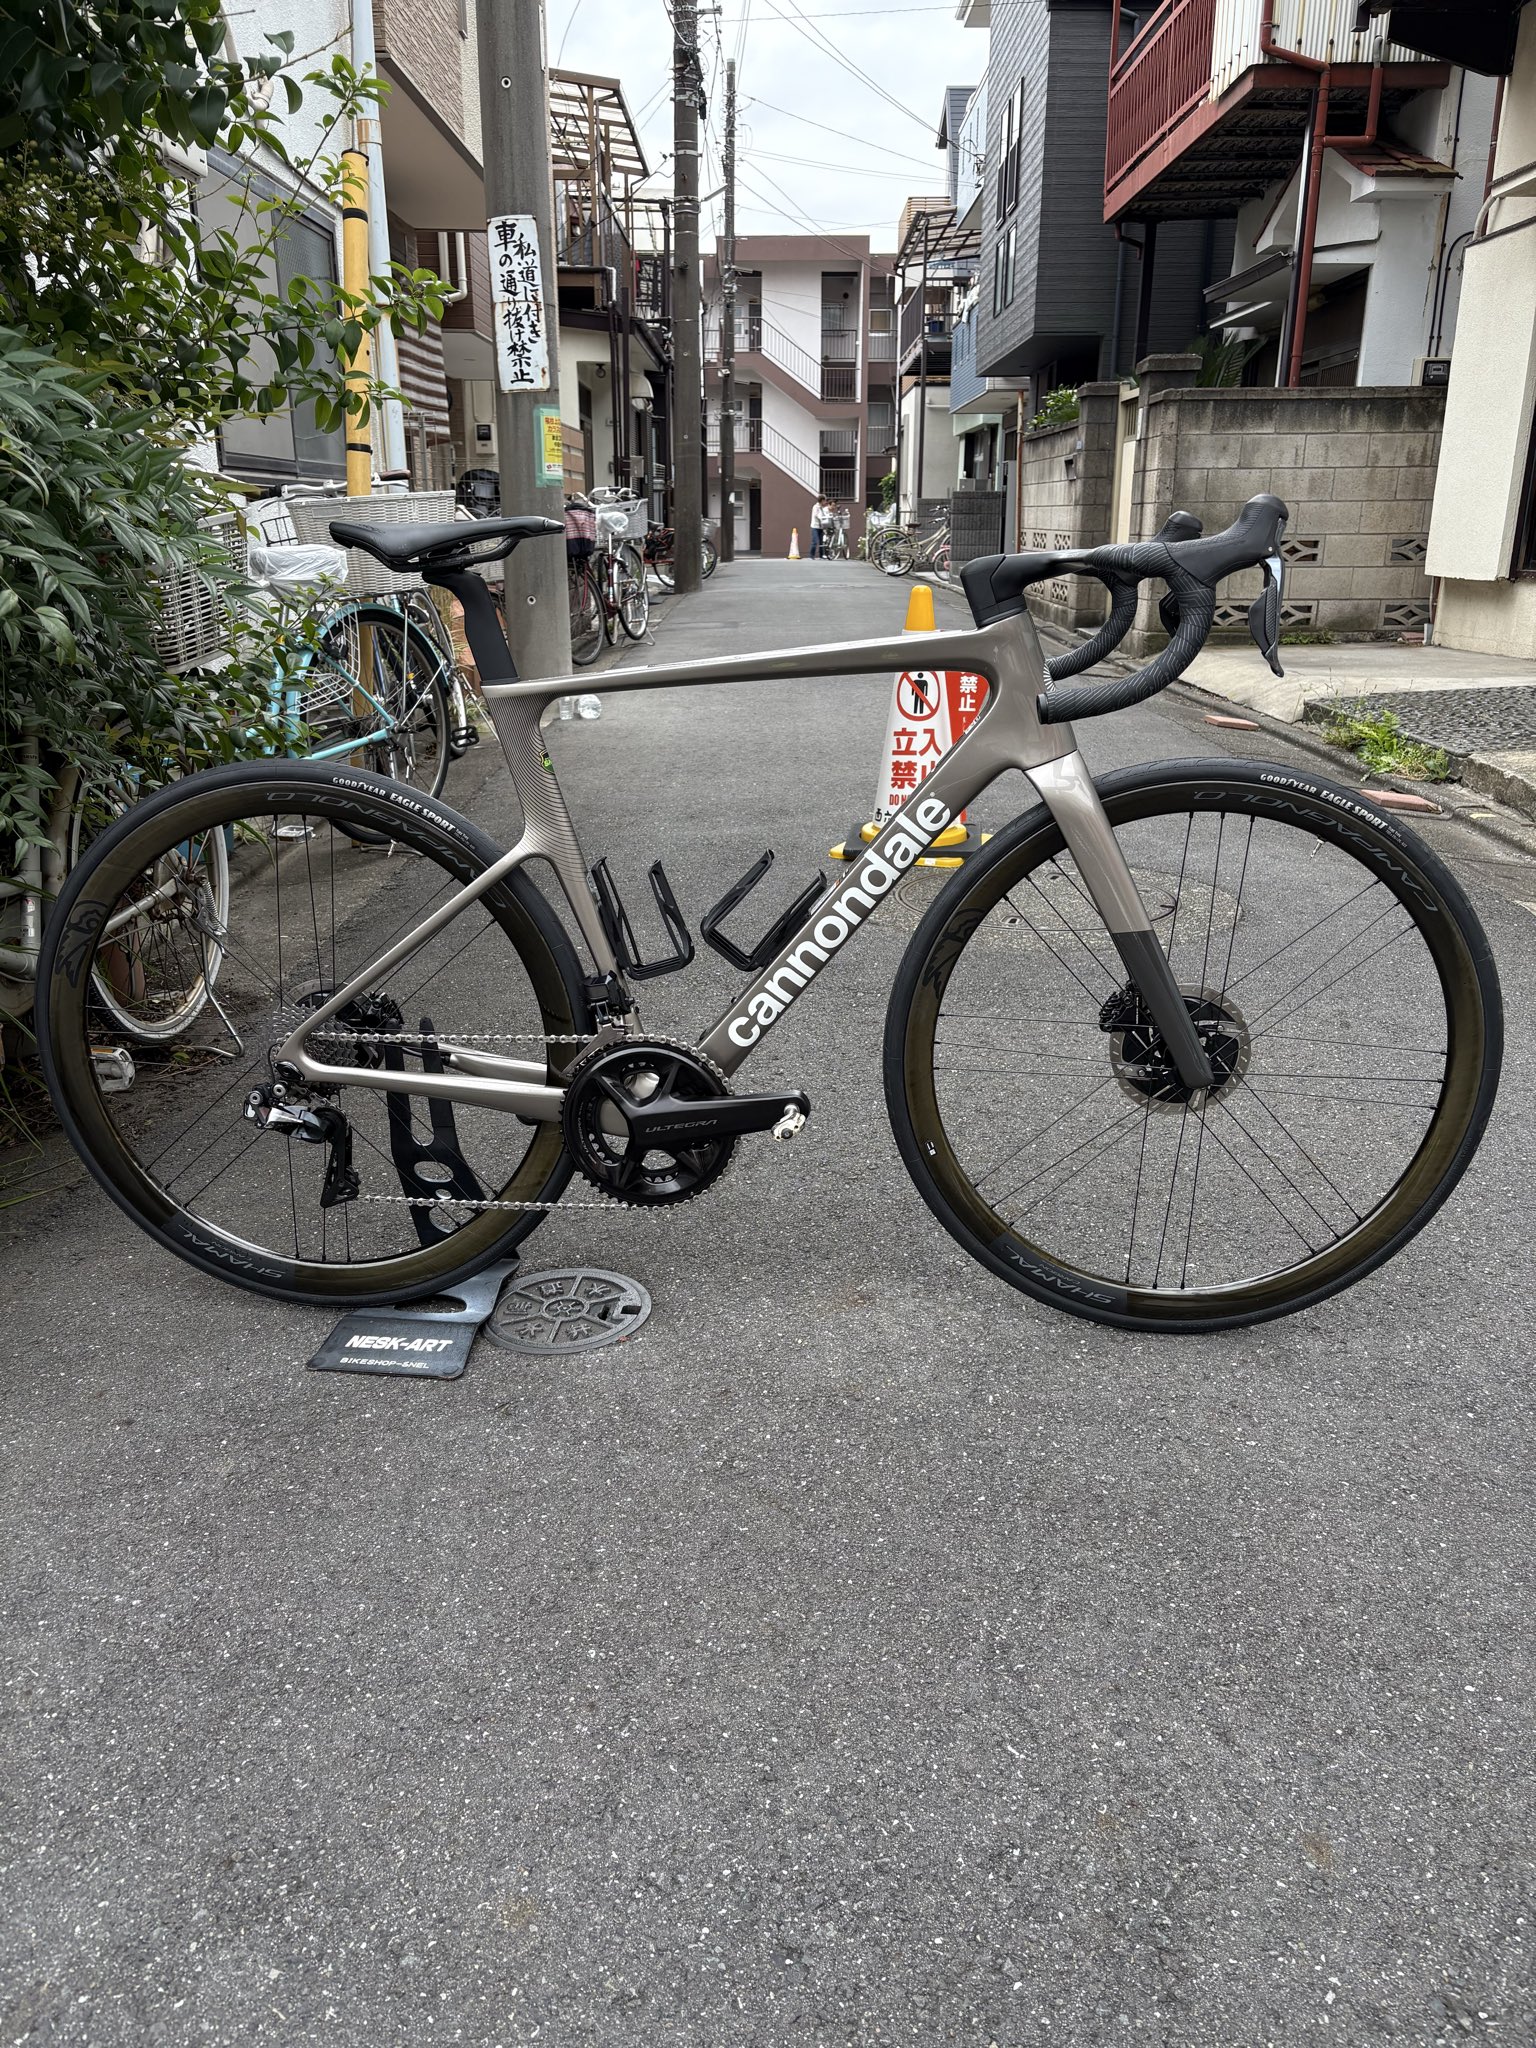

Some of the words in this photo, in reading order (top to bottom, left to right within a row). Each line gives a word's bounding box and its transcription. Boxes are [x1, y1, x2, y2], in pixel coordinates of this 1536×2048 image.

[494, 221, 534, 385] 車の通り抜け禁止
[513, 233, 541, 344] 私道に付き
[958, 671, 978, 712] 禁止
[891, 727, 943, 757] 立入
[389, 792, 422, 814] EAGLE
[421, 808, 456, 832] SPORT
[888, 793, 900, 806] DO
[1320, 790, 1354, 810] EAGLE
[1352, 805, 1388, 830] SPORT
[1194, 791, 1438, 912] CAMPAGNOLO
[728, 798, 951, 1047] cannondale
[645, 1119, 718, 1133] ULTEGRA
[178, 1224, 286, 1279] SHAMAL
[1005, 1245, 1117, 1304] SHAMAL
[344, 1334, 454, 1352] NESK-ART
